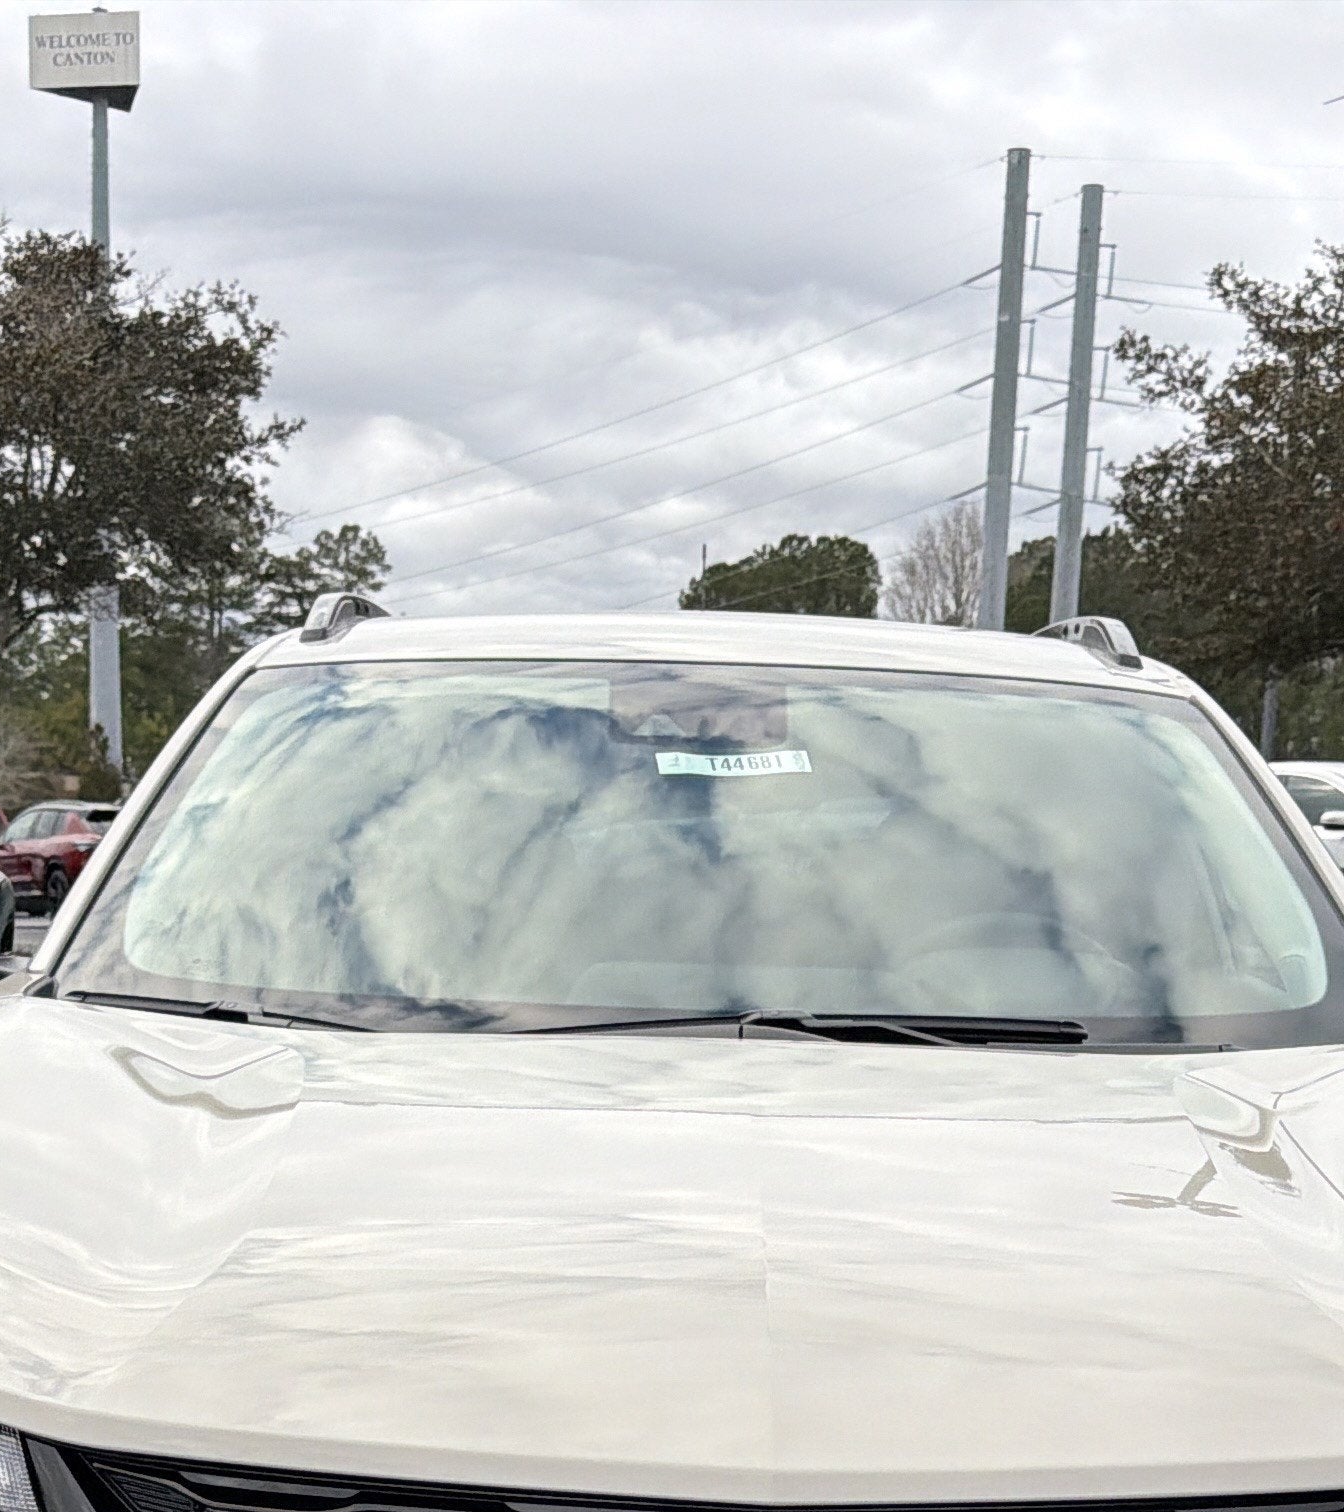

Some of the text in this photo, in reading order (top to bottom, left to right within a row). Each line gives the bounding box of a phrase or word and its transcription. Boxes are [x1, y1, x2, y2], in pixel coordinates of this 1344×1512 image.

[35, 32, 135, 49] WELCOME TO
[53, 51, 115, 66] CANTON
[705, 755, 783, 771] T44681
